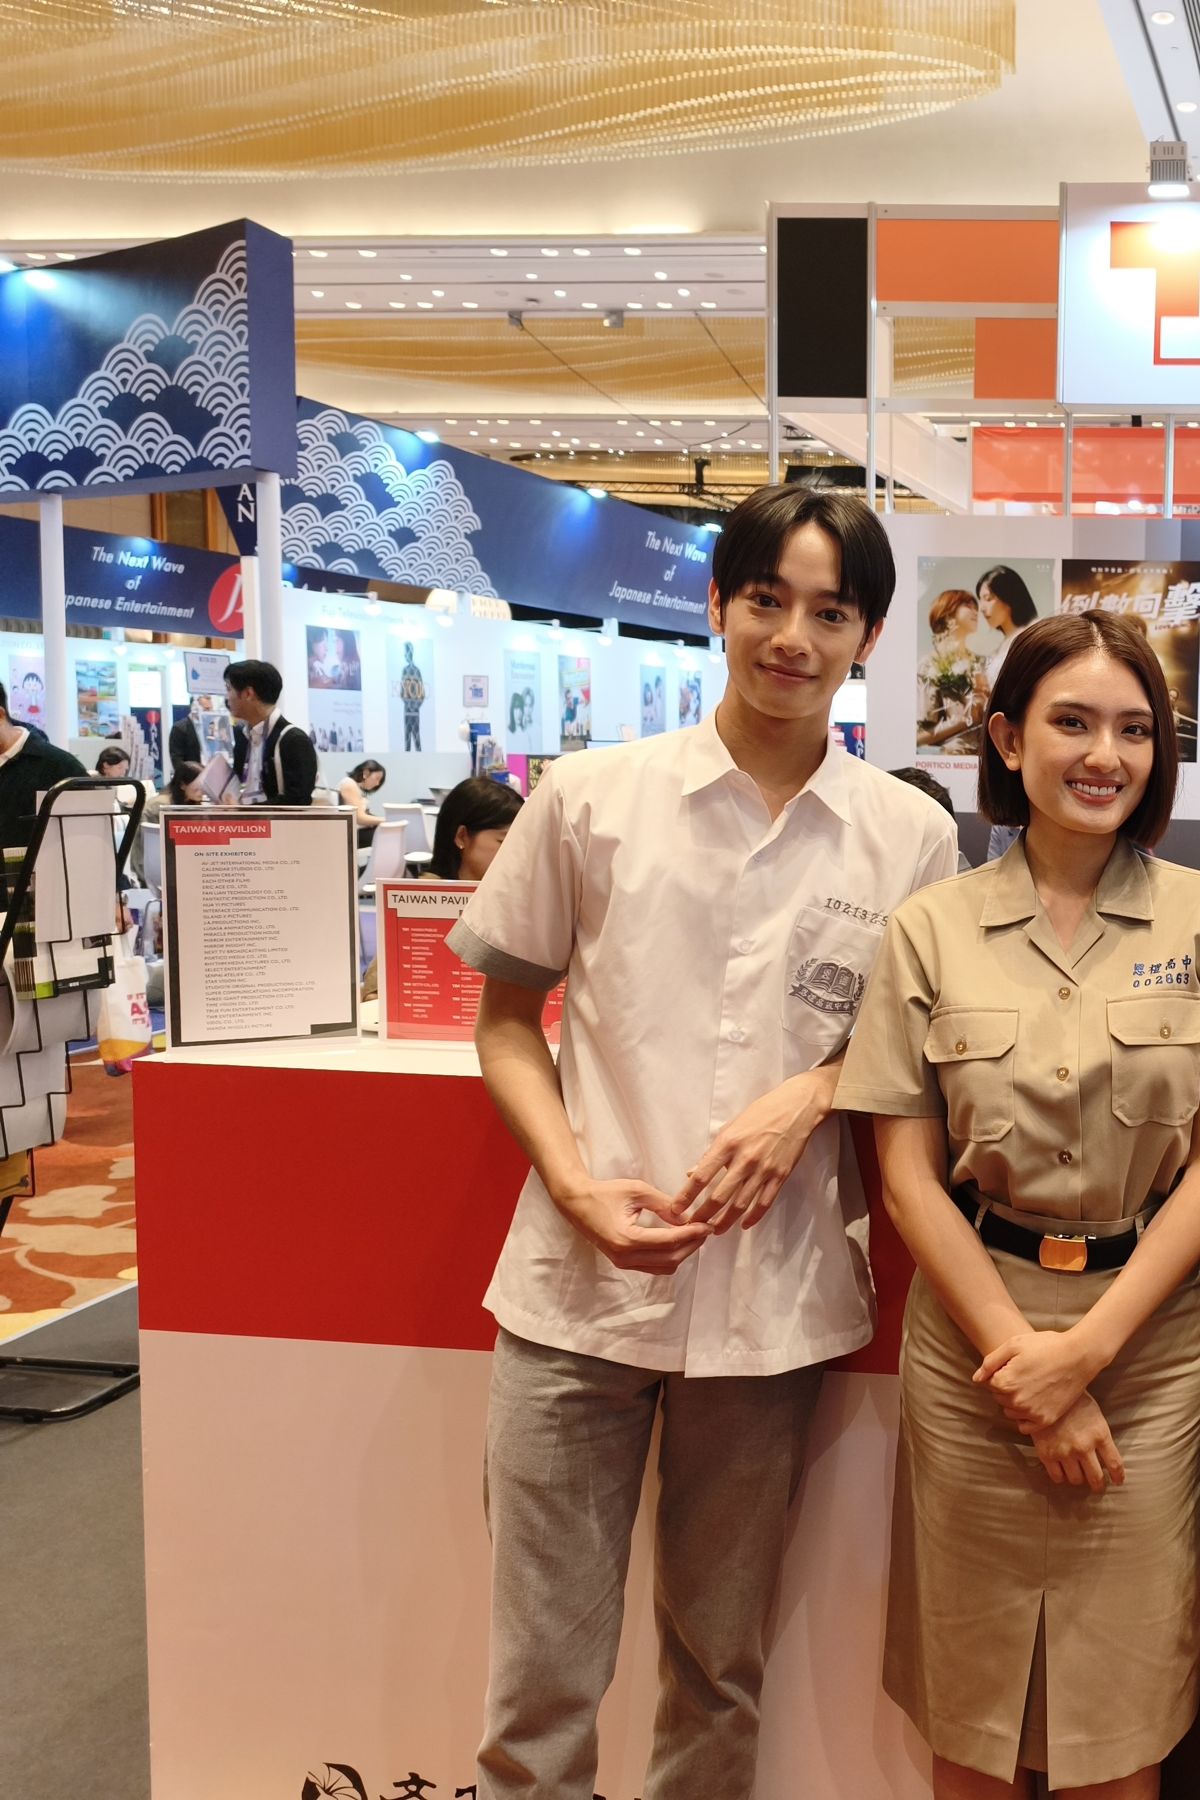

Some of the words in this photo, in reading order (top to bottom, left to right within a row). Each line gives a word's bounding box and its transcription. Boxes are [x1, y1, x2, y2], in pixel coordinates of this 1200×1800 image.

[645, 531, 661, 550] The
[662, 536, 684, 553] Next
[684, 542, 707, 563] Wave
[92, 546, 113, 564] The
[117, 550, 149, 569] Next
[151, 555, 185, 574] Wave
[664, 565, 677, 581] of
[125, 575, 142, 590] of
[65, 593, 112, 610] panese
[114, 597, 194, 618] Entertainment
[609, 581, 651, 604] Japanese
[652, 590, 707, 615] Entertainment
[915, 761, 951, 769] PORTICO
[953, 762, 978, 770] MEDIA
[174, 825, 216, 834] TAIWAN
[218, 825, 266, 833] PAVILION
[392, 894, 437, 905] TAIWAN
[824, 898, 889, 927] 1021325
[1133, 973, 1190, 988] 002863
